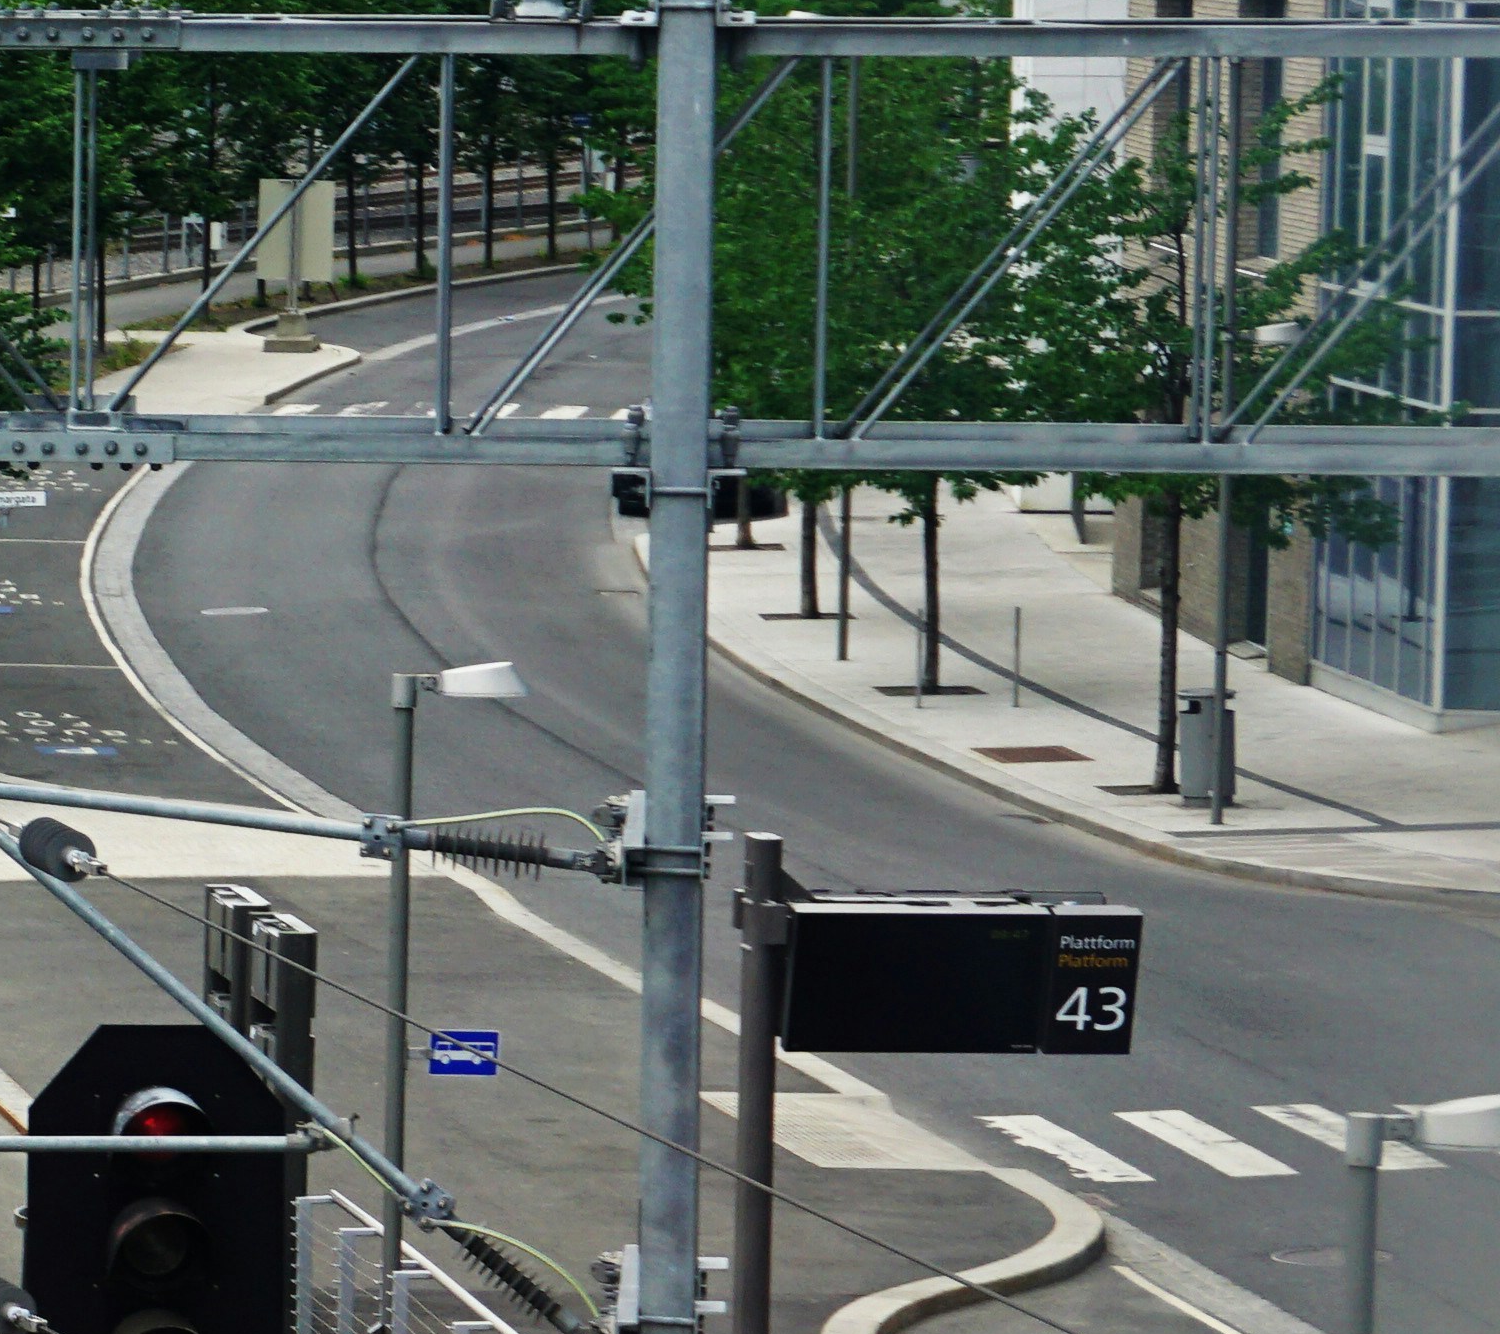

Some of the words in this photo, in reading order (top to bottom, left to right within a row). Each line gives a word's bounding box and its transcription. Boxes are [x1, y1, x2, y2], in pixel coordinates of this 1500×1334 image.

[1059, 935, 1136, 950] Plattform
[1057, 953, 1129, 968] Platform
[1055, 986, 1127, 1031] 43
